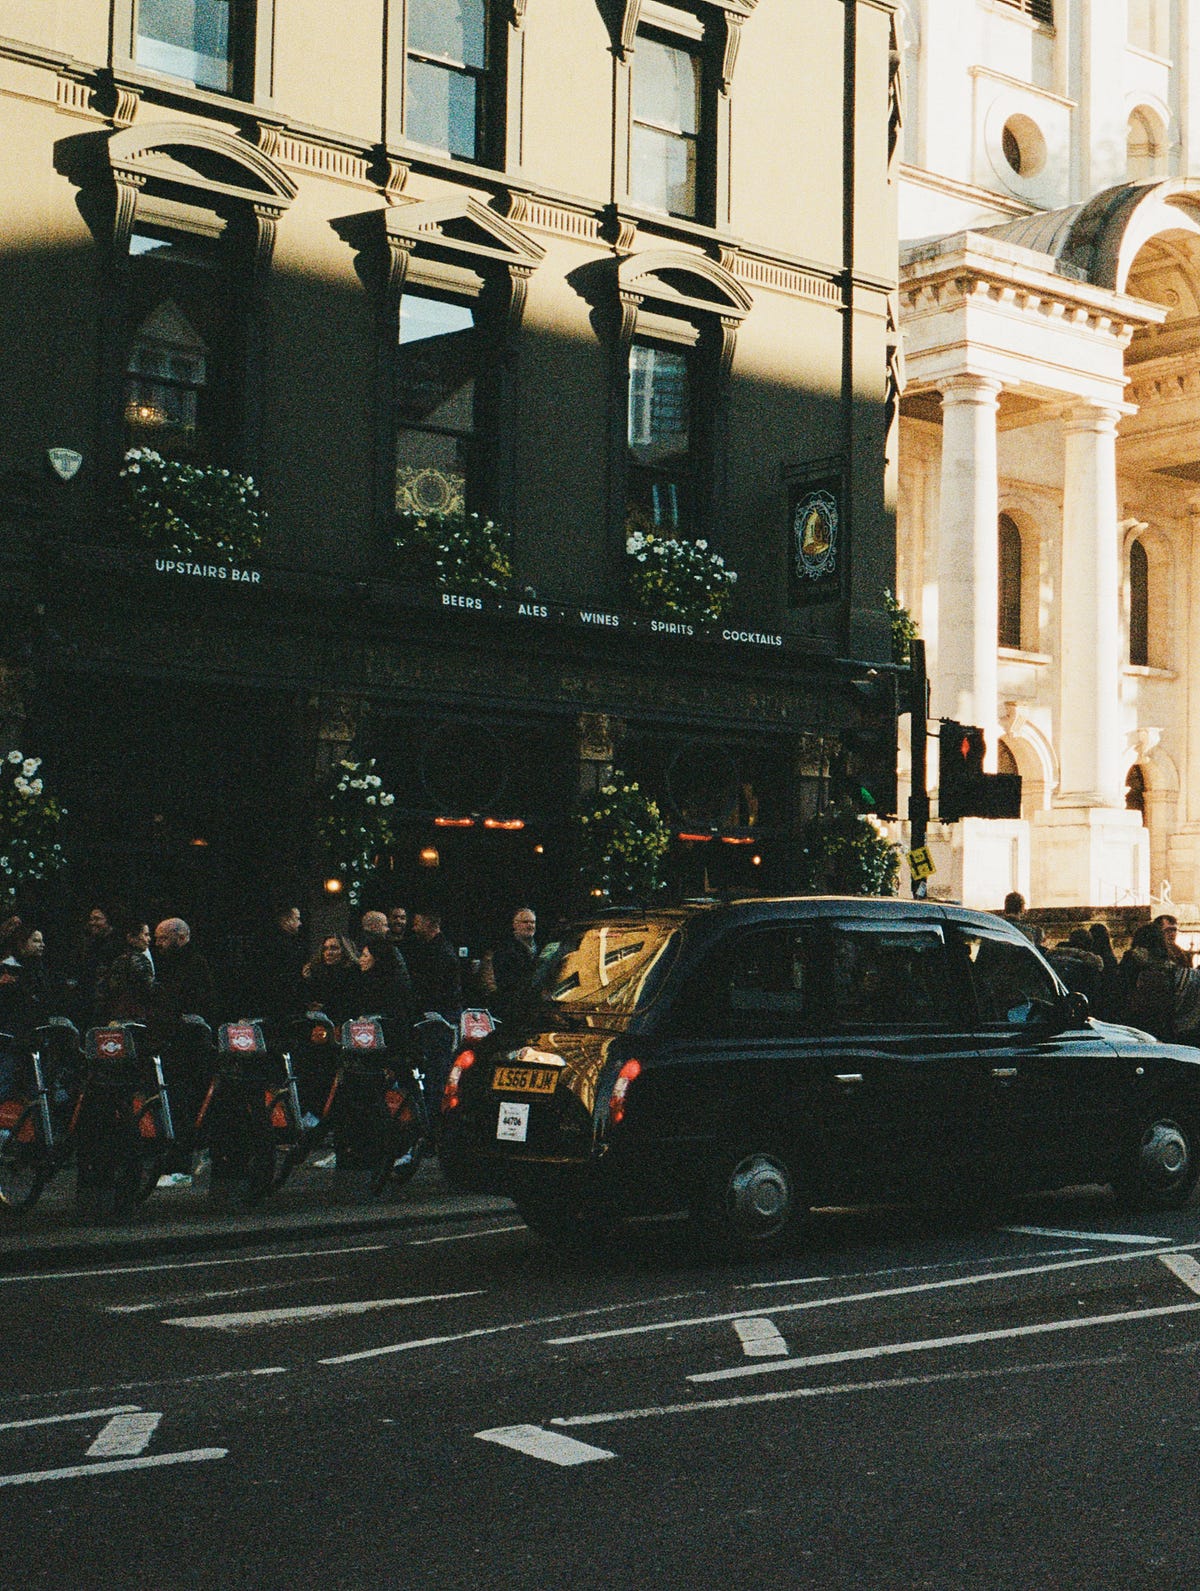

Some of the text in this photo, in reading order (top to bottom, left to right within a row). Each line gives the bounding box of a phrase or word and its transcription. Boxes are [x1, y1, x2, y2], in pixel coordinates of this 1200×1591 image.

[155, 559, 261, 584] UPSTAIRS BAR
[442, 594, 783, 646] BEERS ALES WINES SPIRITS COCKTAILS
[496, 1069, 529, 1089] LS66
